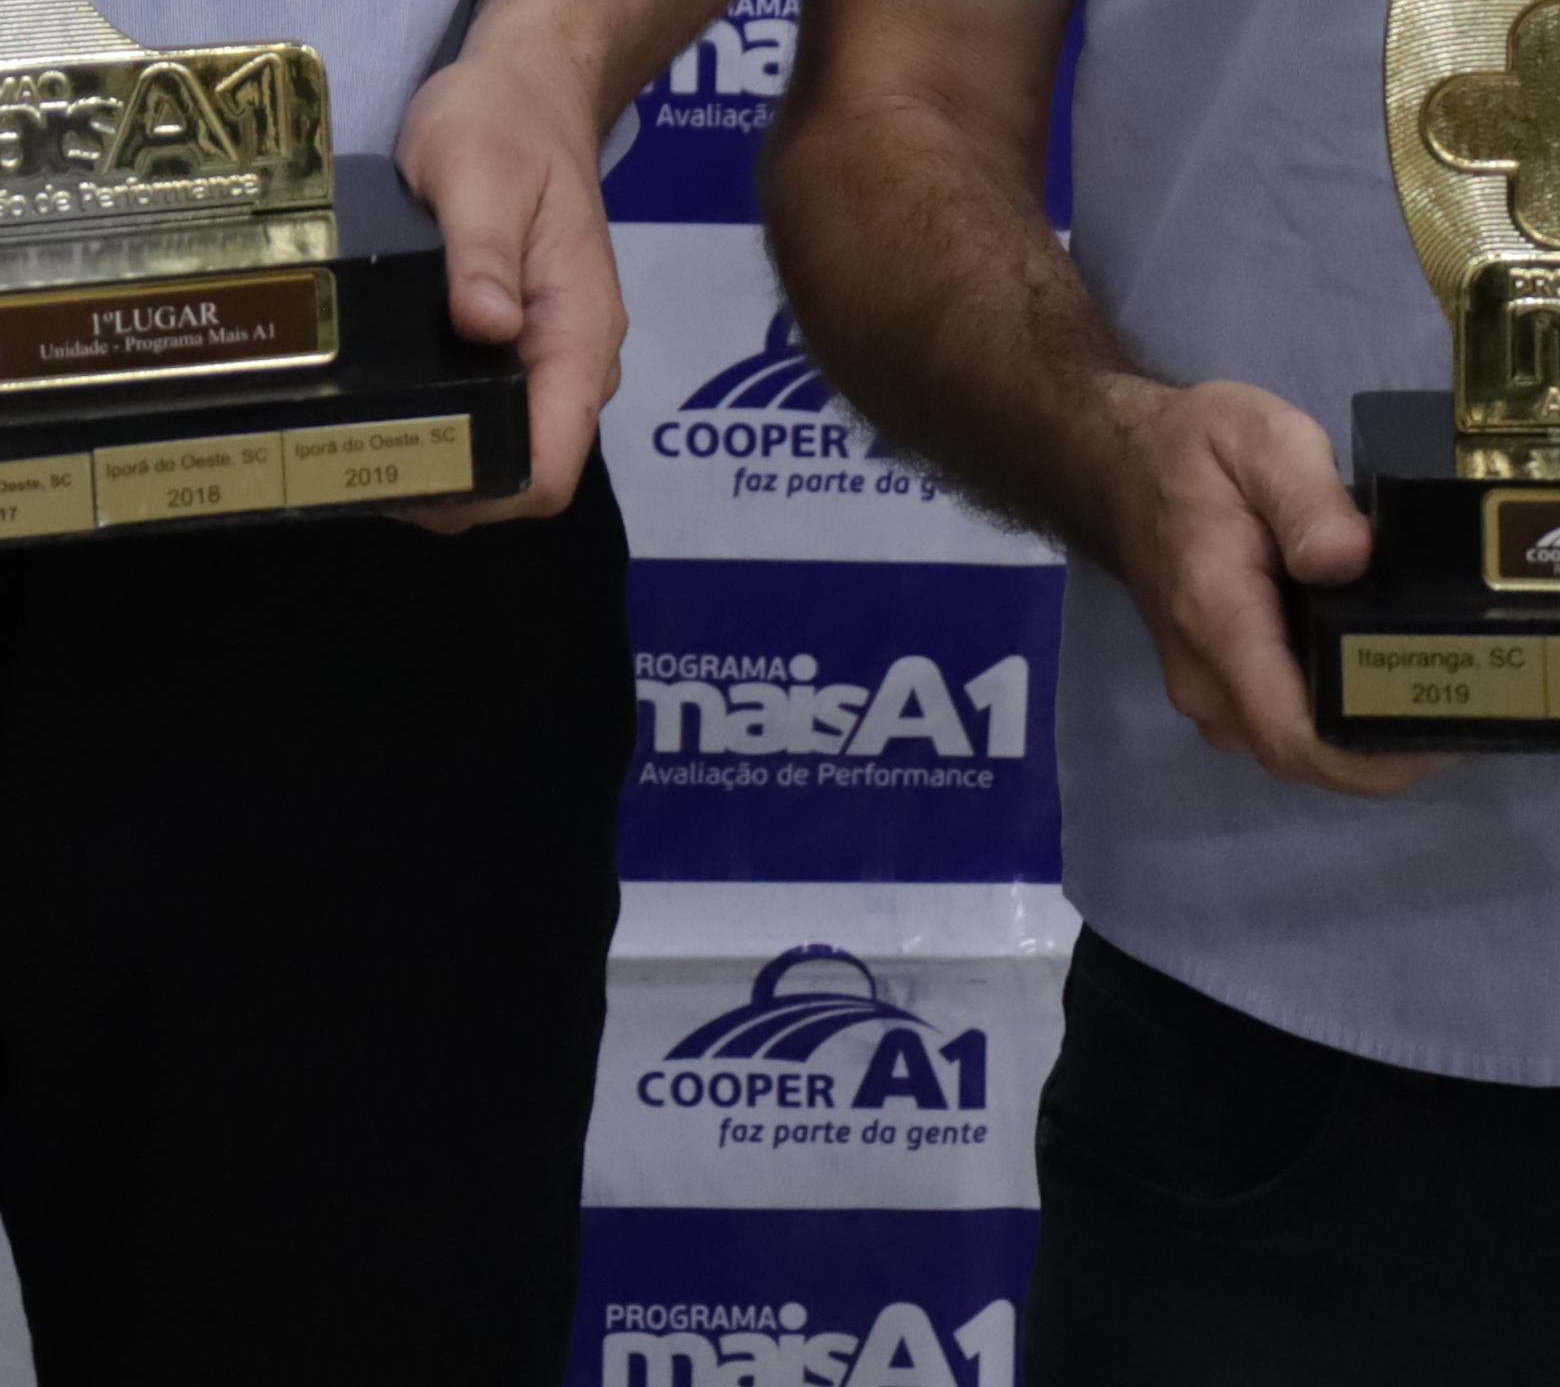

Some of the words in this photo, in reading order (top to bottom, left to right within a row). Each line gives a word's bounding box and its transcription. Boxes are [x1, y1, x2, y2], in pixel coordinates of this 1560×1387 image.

[34, 184, 72, 216] de
[78, 174, 260, 210] Performance
[40, 338, 109, 361] Unidade
[125, 333, 205, 356] Programa
[209, 326, 250, 345] Mais
[253, 323, 276, 340] A1
[341, 435, 365, 453] do
[430, 427, 456, 445] SC
[154, 455, 176, 472] do
[241, 446, 269, 465] SC
[50, 472, 73, 489] SC
[344, 464, 399, 489] 2019
[166, 485, 222, 509] 2018
[1488, 647, 1526, 669] SC
[1411, 683, 1470, 705] 2019
[637, 1071, 835, 1109] COOPER
[851, 1027, 987, 1110] A1
[719, 1118, 762, 1148] faz
[773, 1120, 851, 1149] parte
[861, 1119, 896, 1145] da
[907, 1123, 988, 1150] gente
